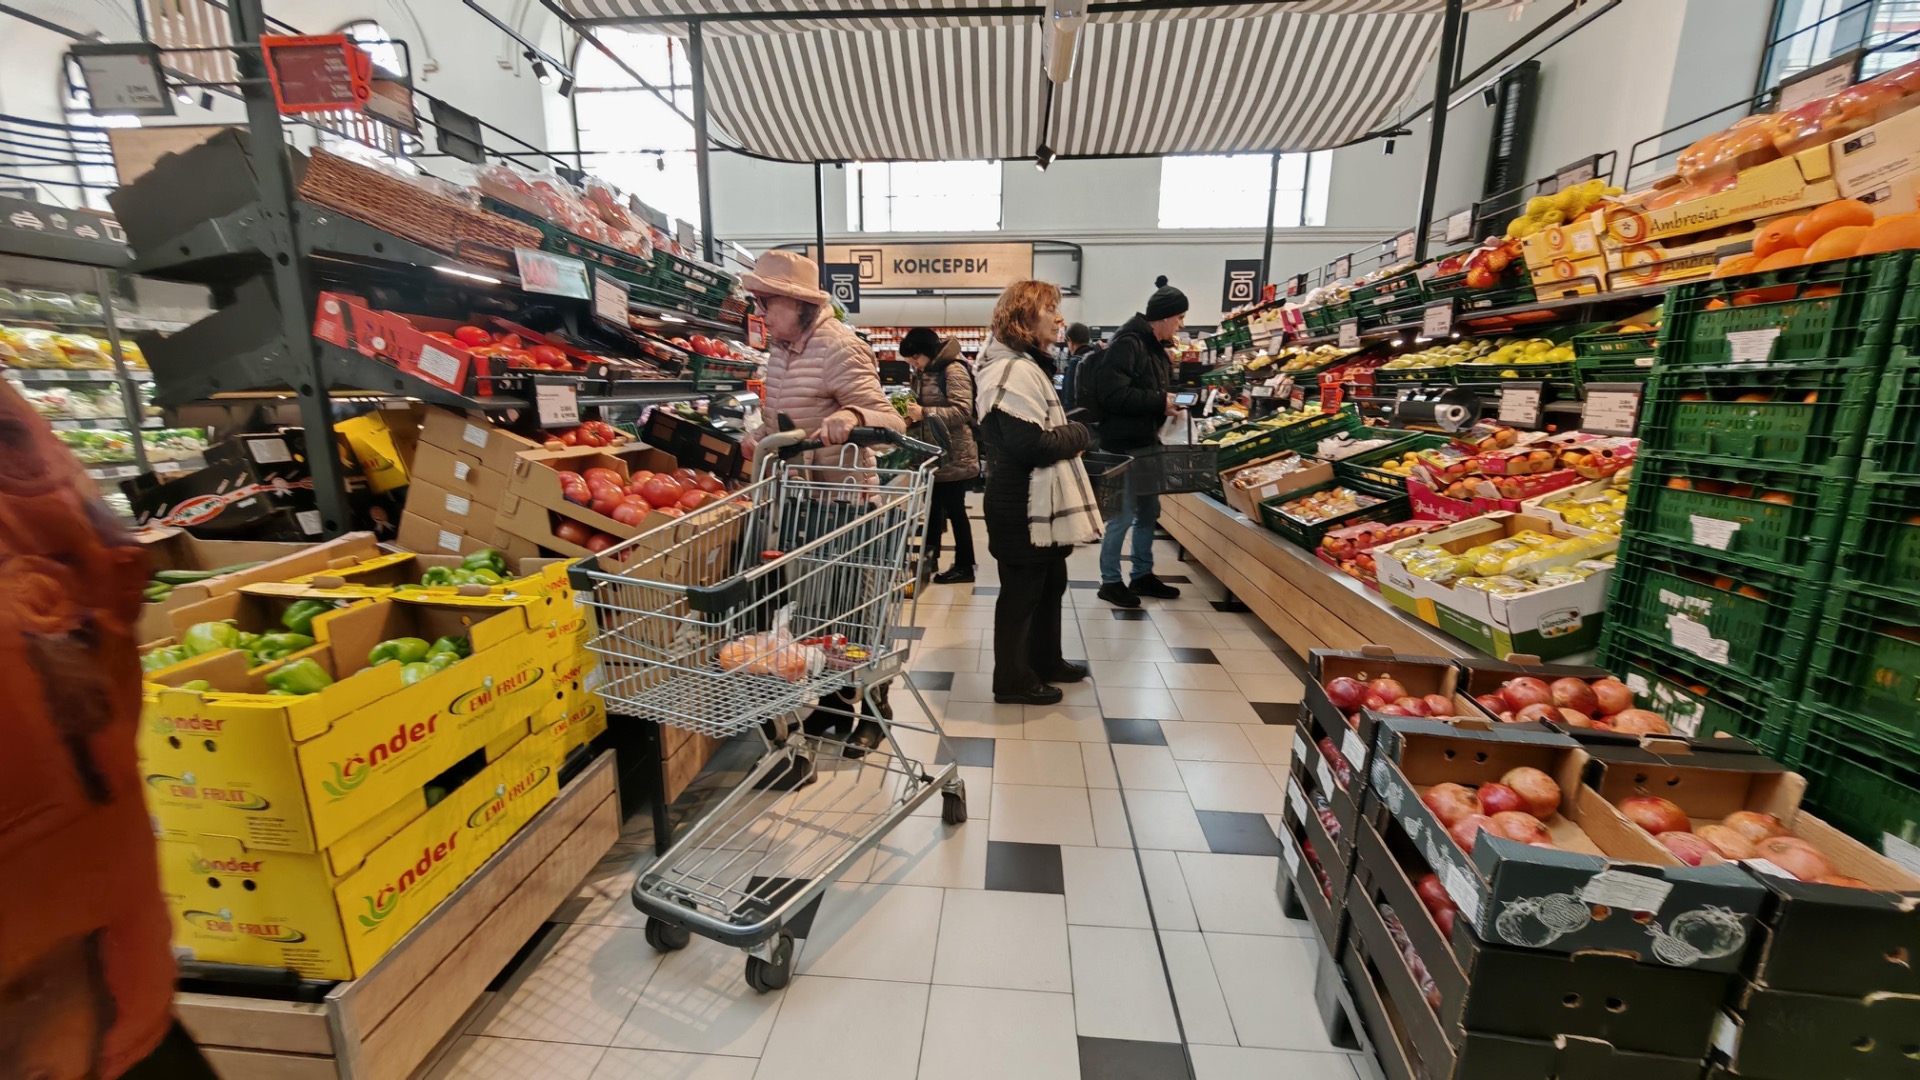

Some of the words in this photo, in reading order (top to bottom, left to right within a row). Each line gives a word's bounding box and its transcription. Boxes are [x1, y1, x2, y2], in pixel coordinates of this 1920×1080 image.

[1650, 207, 1720, 233] Ambrosia
[893, 258, 988, 274] КОНСЕРВИ
[468, 690, 493, 713] EMI
[496, 669, 529, 697] FRUIT
[508, 772, 537, 802] FRUIT
